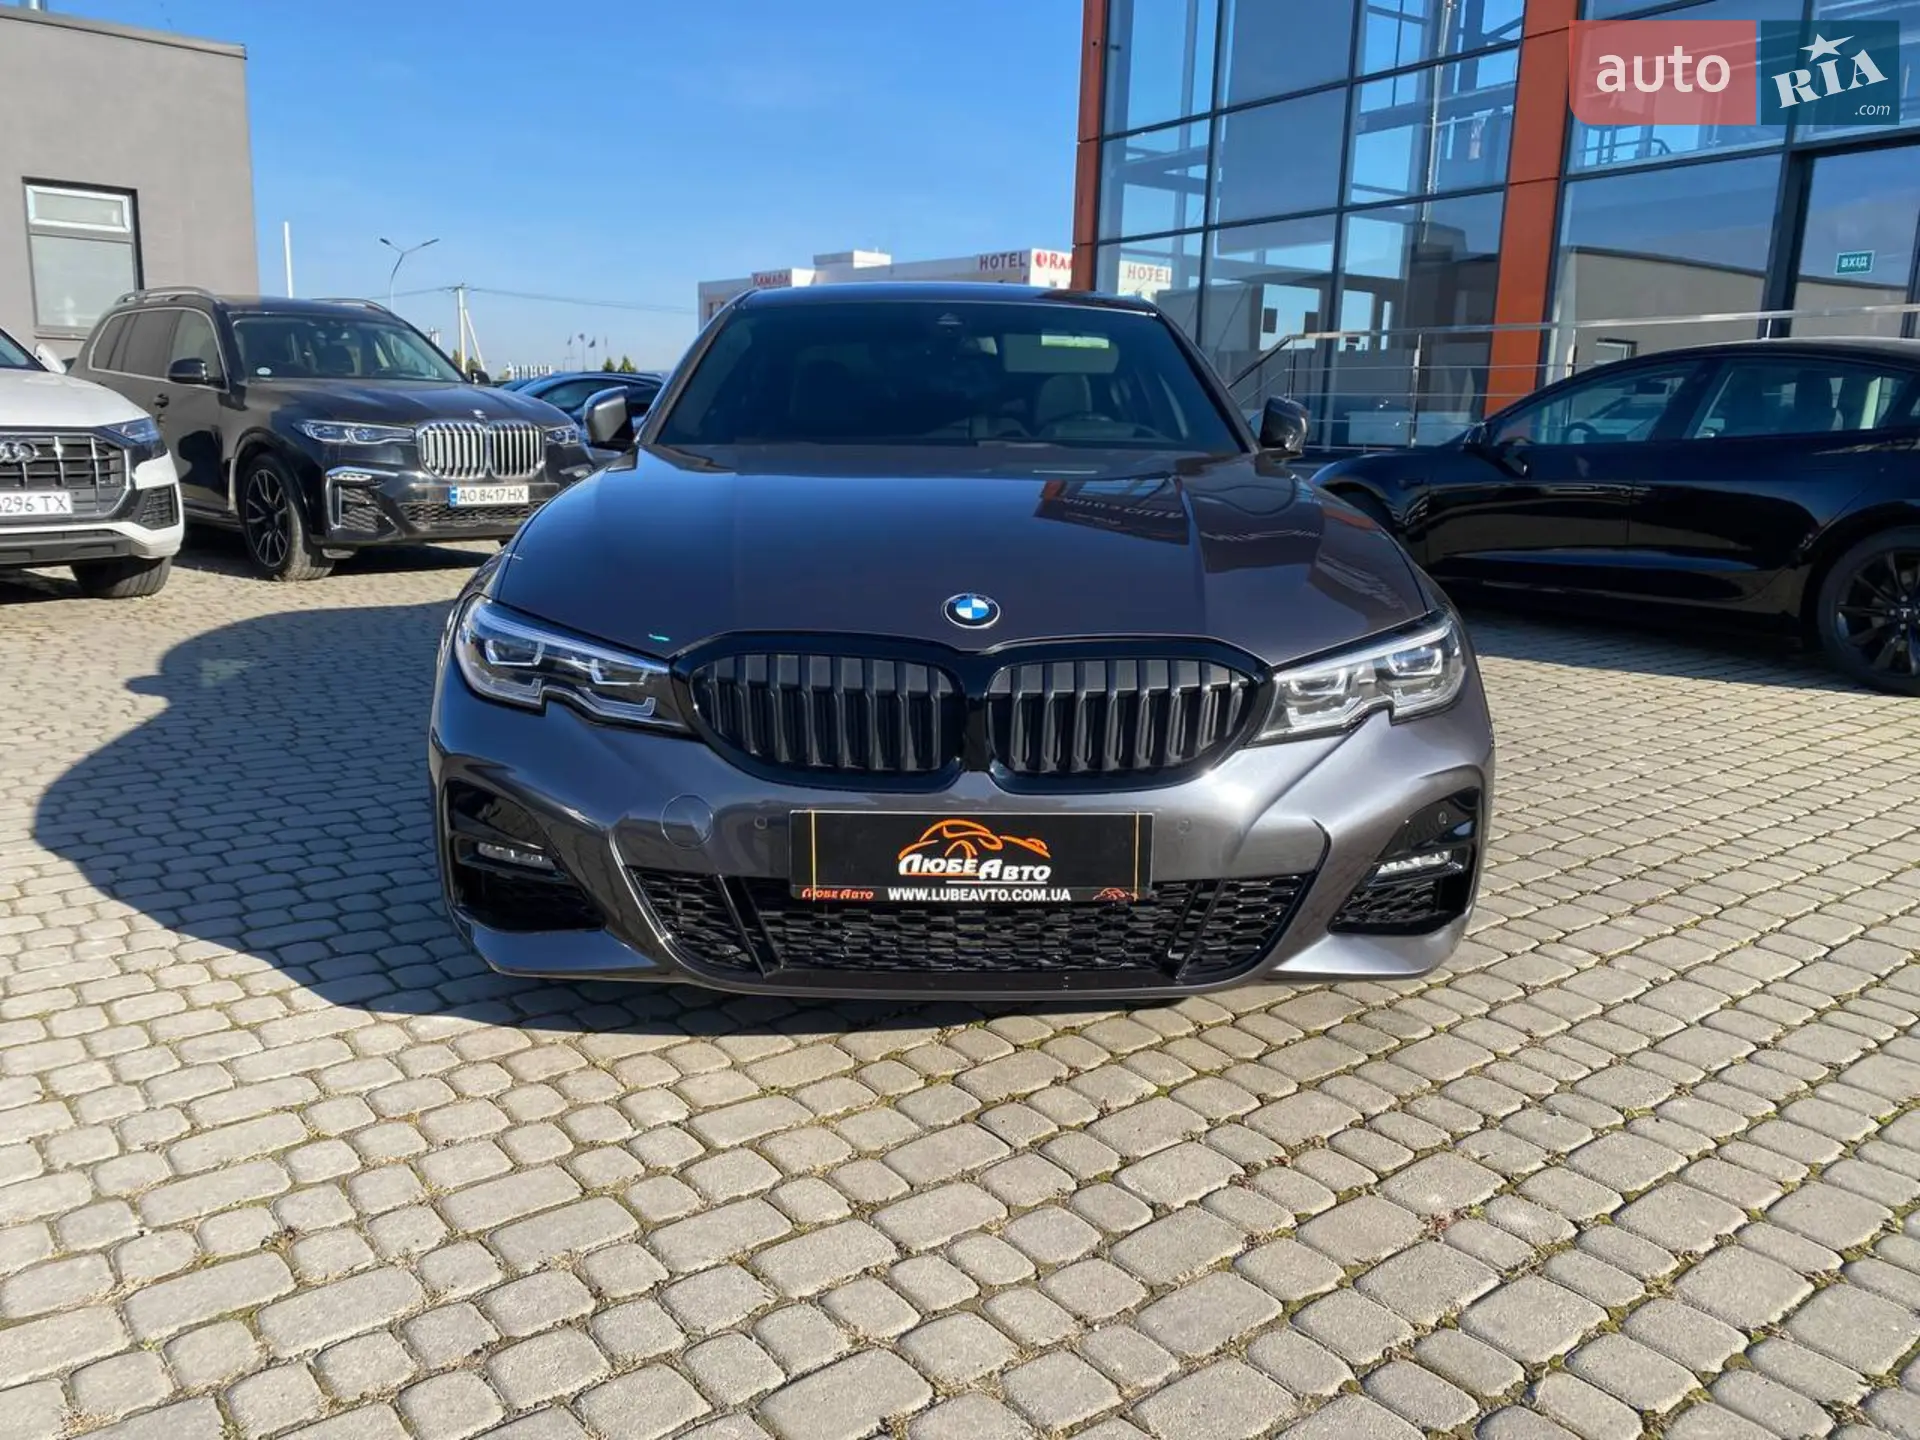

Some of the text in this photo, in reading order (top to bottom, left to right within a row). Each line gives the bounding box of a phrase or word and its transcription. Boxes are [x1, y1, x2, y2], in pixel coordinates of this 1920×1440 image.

[979, 252, 1026, 271] HOTEL
[1127, 264, 1170, 284] HOTEL
[479, 488, 506, 502] 8417
[508, 487, 525, 500] HX
[0, 495, 68, 513] 296 TX
[887, 887, 1072, 902] WWW.LUBEAVTO.COM.UA
